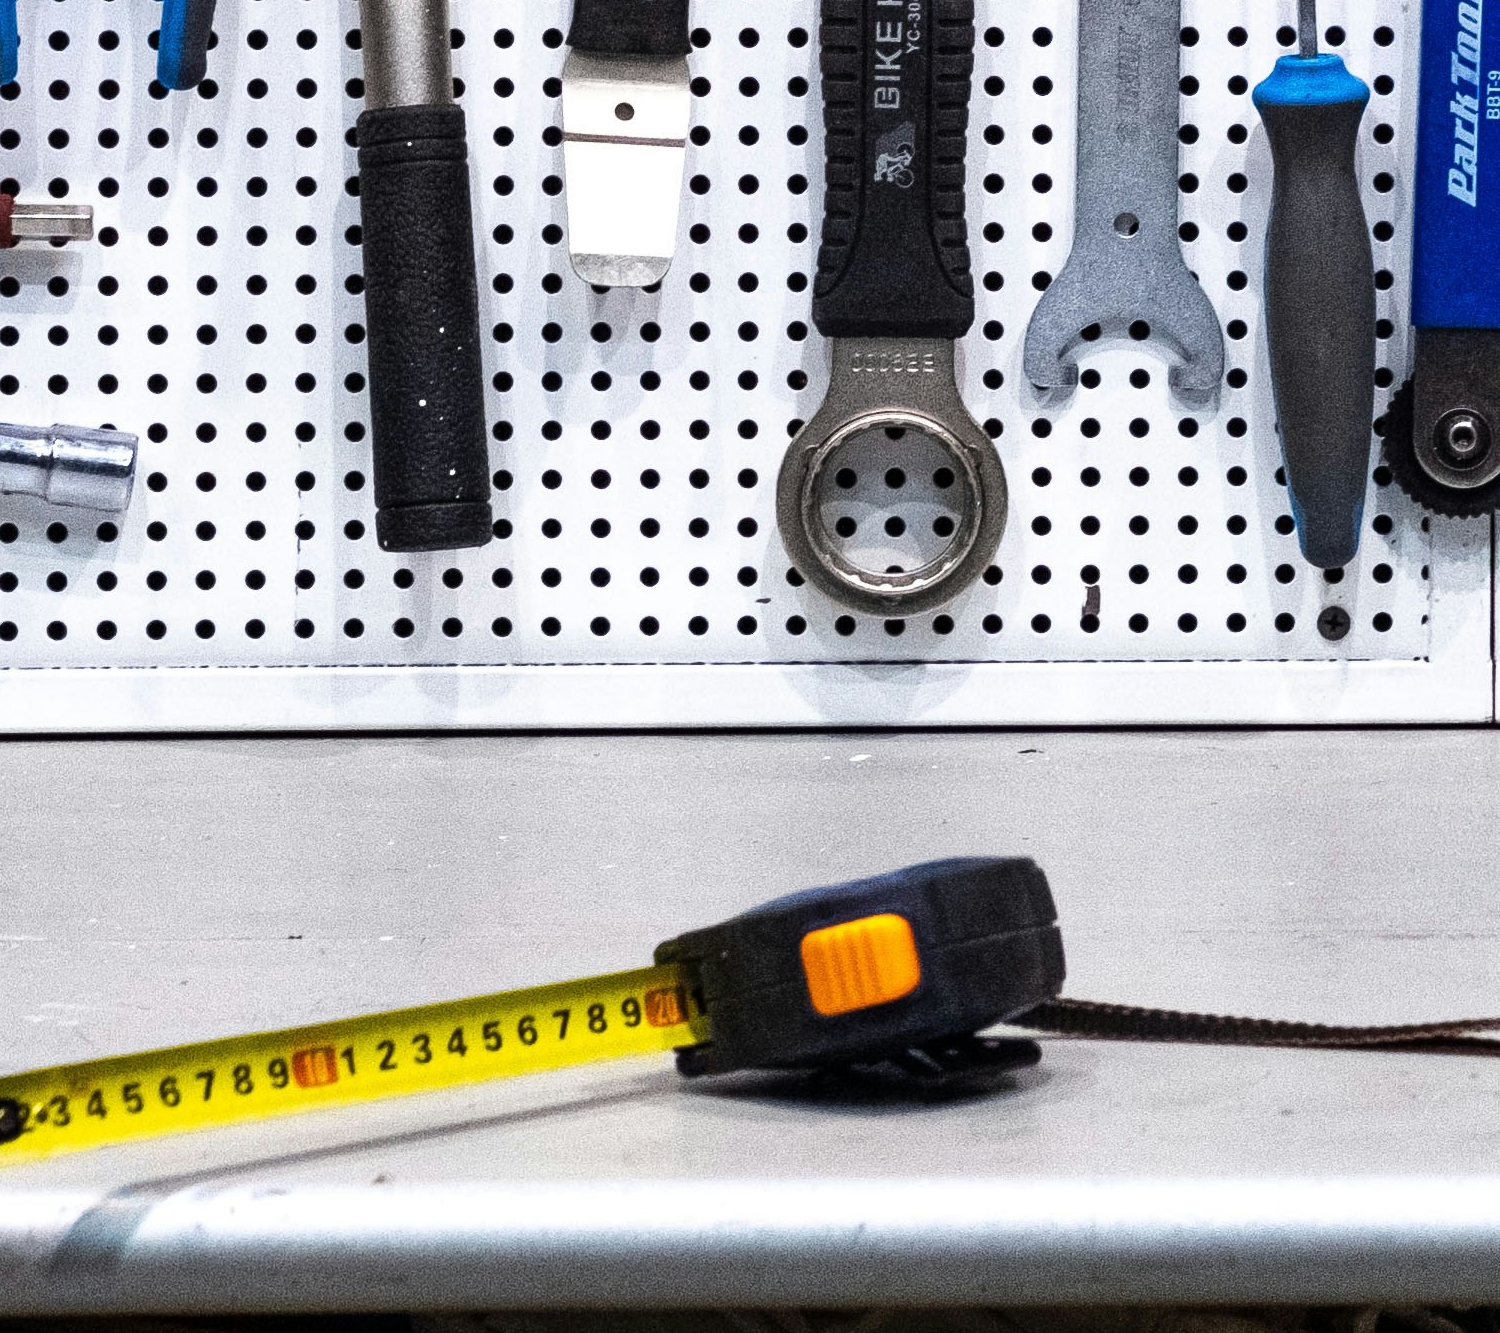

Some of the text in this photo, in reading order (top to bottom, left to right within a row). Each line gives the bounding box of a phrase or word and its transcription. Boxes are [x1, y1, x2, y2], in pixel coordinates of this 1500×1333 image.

[873, 21, 903, 110] BIKE
[50, 1095, 70, 1124] 3
[88, 1089, 106, 1117] 4
[122, 1083, 143, 1112] 5
[159, 1076, 179, 1105] 6
[196, 1070, 214, 1099] 7
[232, 1064, 252, 1093] 8
[268, 1058, 289, 1087] 9
[342, 1047, 355, 1072] 1
[378, 1040, 396, 1070] 2
[413, 1033, 432, 1063] 3
[447, 1027, 467, 1055] 4
[483, 1021, 502, 1051] 5
[518, 1015, 537, 1044] 6
[553, 1009, 570, 1038] 7
[587, 1003, 607, 1032] 8
[621, 997, 641, 1026] 9
